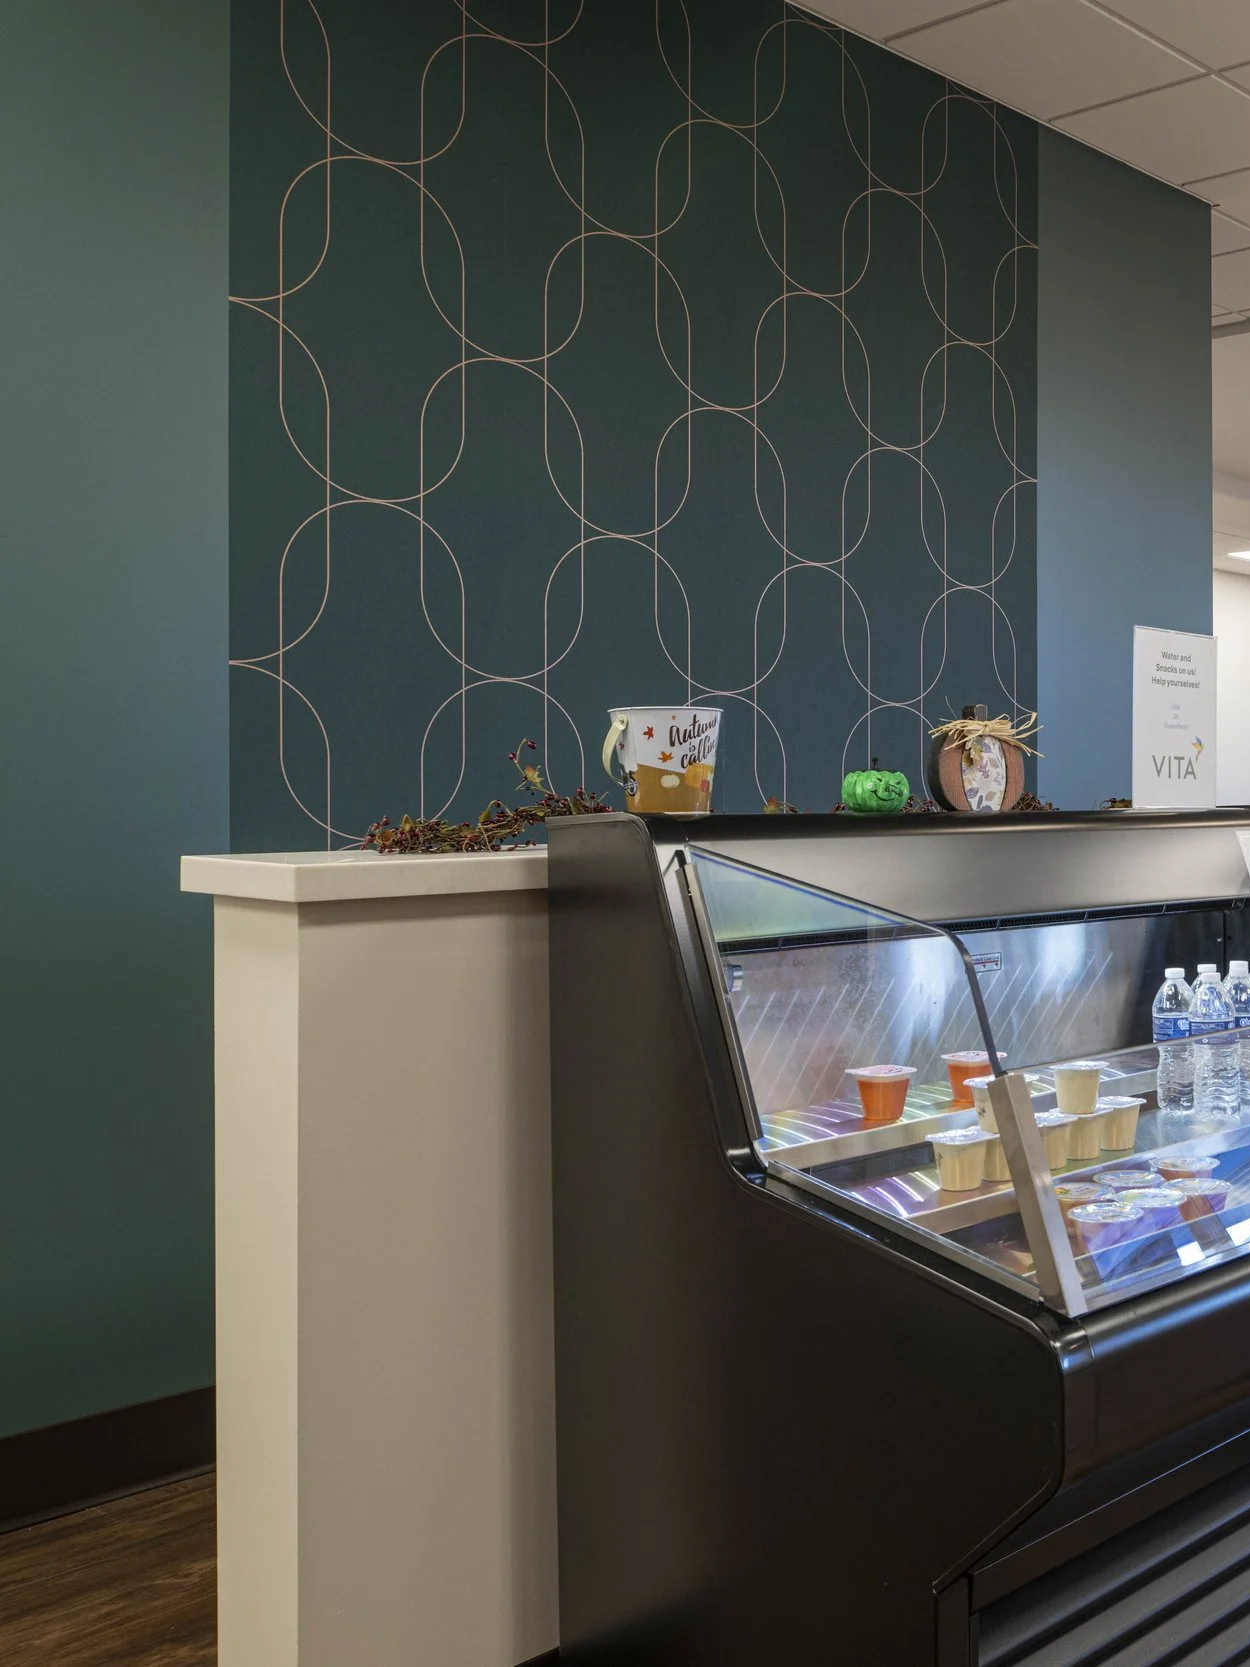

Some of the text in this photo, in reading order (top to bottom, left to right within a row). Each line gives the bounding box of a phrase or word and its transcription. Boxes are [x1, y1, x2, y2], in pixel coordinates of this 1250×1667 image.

[1161, 651, 1191, 662] Water and
[1156, 663, 1196, 676] Snacks on us!
[1151, 676, 1200, 689] Help yourselves!
[1152, 755, 1196, 780] VITA
